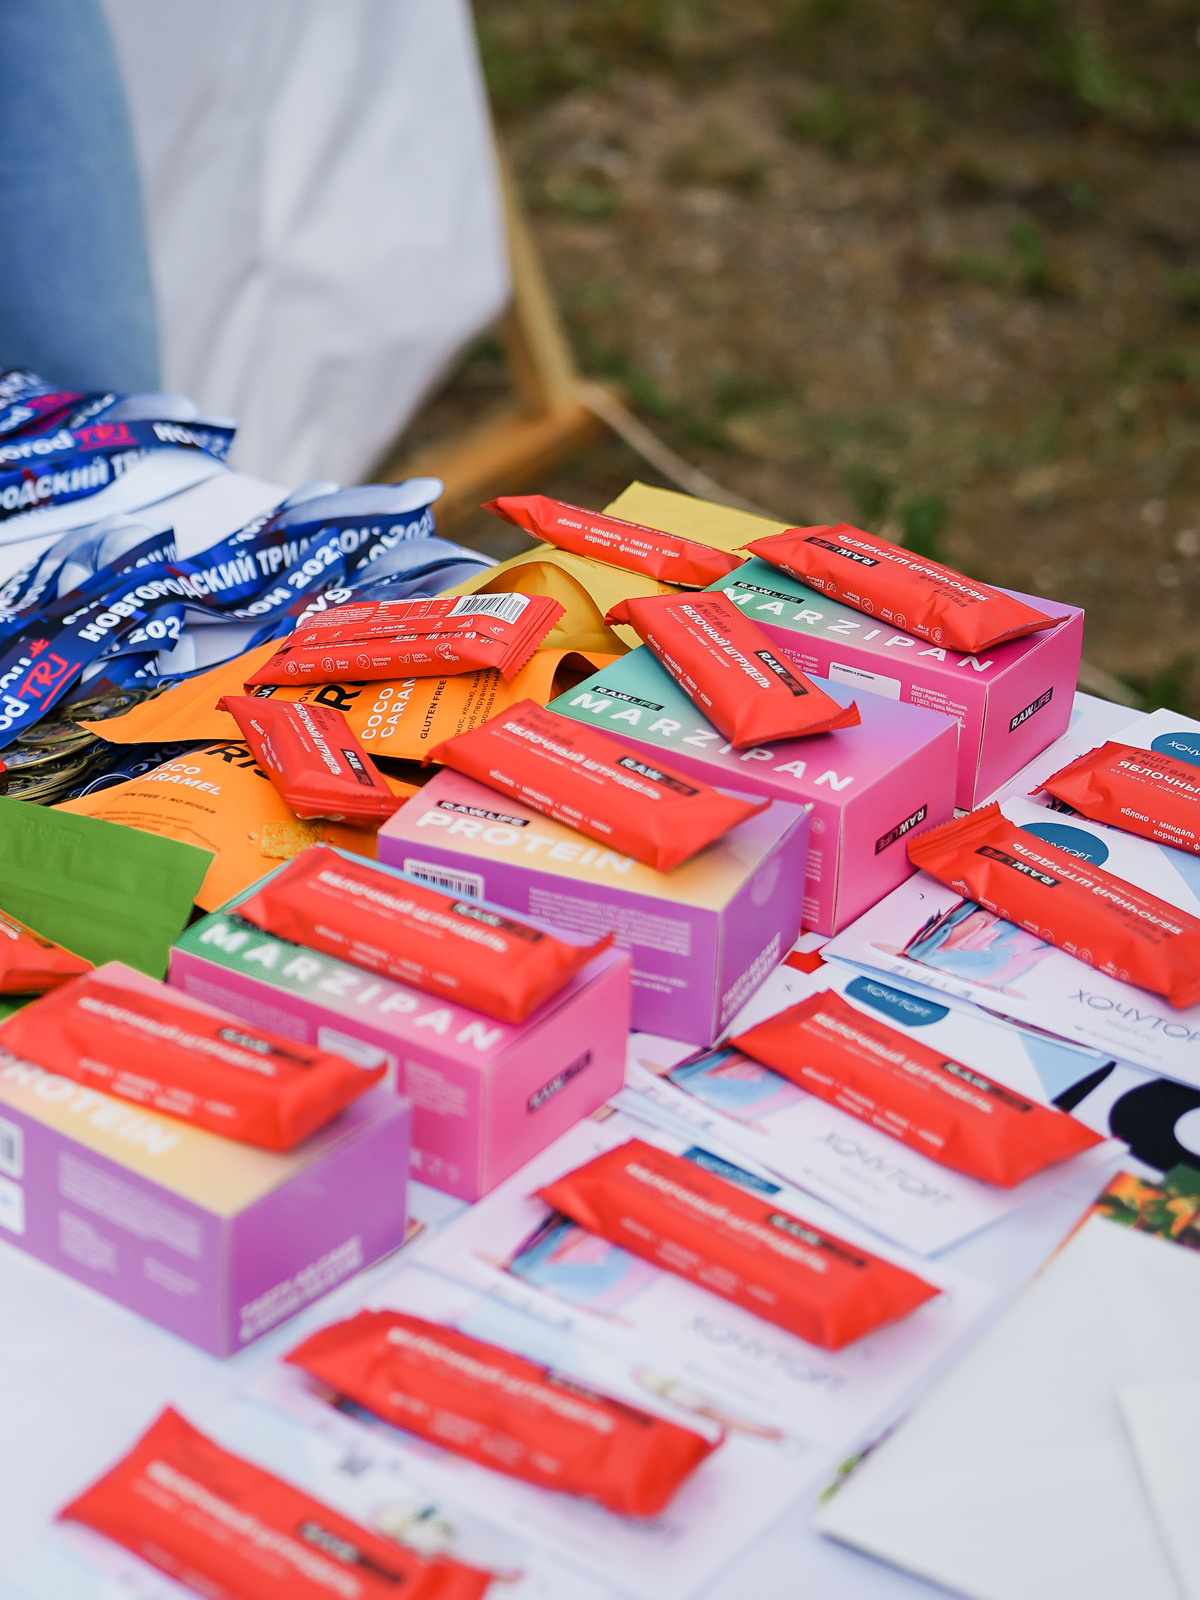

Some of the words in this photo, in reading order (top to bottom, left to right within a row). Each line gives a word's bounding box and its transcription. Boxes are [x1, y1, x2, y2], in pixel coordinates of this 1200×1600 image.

[584, 534, 611, 547] корица
[590, 526, 622, 542] миндаль
[630, 538, 653, 551] пекан
[838, 534, 909, 572] ШТРУДЕЛЬ
[78, 552, 257, 642] НОВГОРОДСКИЙ
[908, 563, 990, 602] ЯБЛОЧНЫЙ
[709, 602, 731, 619] FRUIT
[723, 587, 994, 672] MARZIPAN
[679, 604, 727, 647] ЯБЛОЧНЫЙ
[722, 645, 770, 689] ШТРУДЕЛЬ
[361, 688, 394, 739] COCO
[421, 702, 438, 739] GLUTEN
[432, 679, 447, 703] FREE
[502, 721, 584, 765] ЯБЛОЧНЫЙ
[582, 756, 662, 800] ШТРУДЕЛЬ
[569, 693, 853, 792] MARZIPAN
[1134, 751, 1174, 765] FRUIT
[141, 773, 223, 796] ARAMEL
[150, 762, 202, 776] OCO
[1139, 759, 1168, 771] NUT
[1169, 769, 1196, 782] BAR
[416, 810, 636, 874] PROTEIN
[1120, 807, 1149, 822] яблоко
[1159, 821, 1196, 839] миндаль
[1153, 829, 1183, 845] корица
[1012, 843, 1093, 889] ШТРУДЕЛЬ
[1091, 885, 1184, 935] ЯБЛОЧНЫЙ
[200, 923, 504, 1052] MARZIPAN
